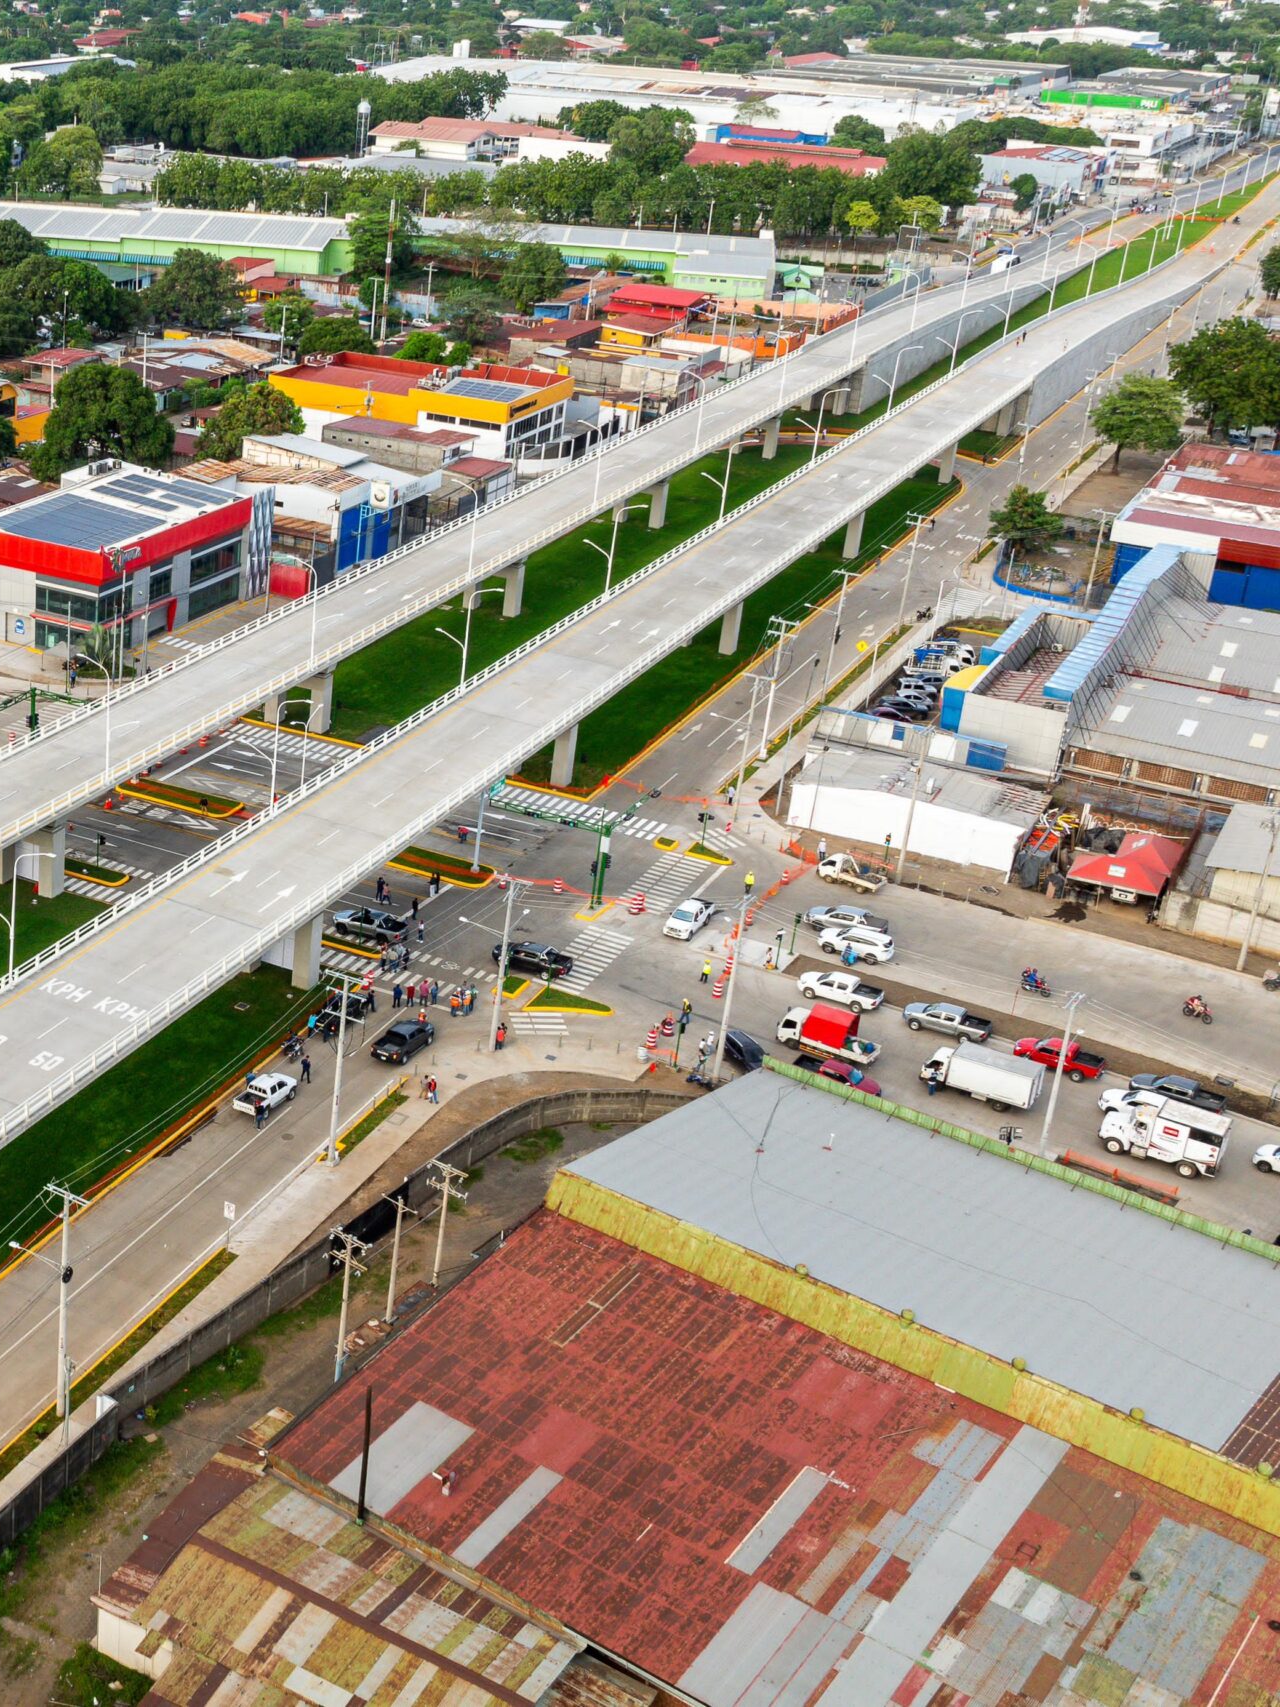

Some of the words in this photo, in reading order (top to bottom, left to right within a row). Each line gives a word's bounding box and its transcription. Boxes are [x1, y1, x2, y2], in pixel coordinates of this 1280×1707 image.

[38, 977, 93, 1003] KPH
[93, 996, 147, 1022] KPH
[28, 1050, 65, 1071] 50
